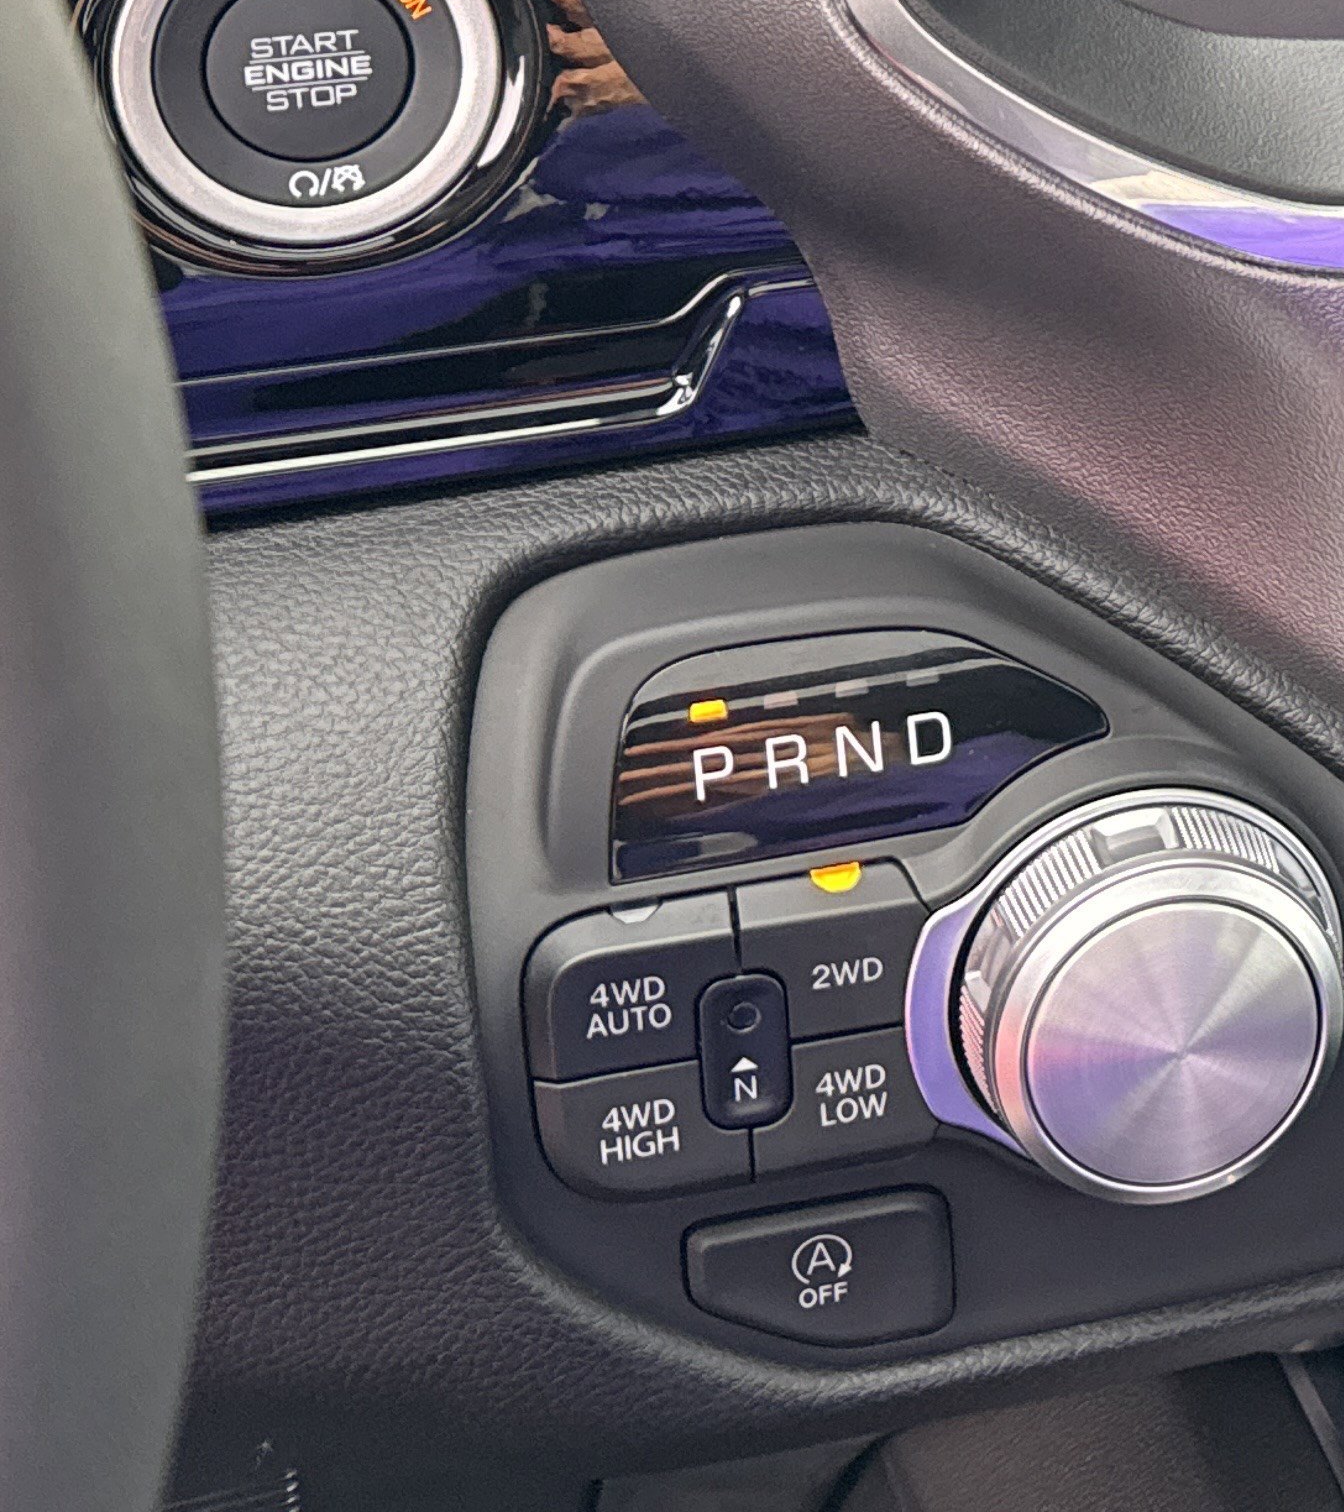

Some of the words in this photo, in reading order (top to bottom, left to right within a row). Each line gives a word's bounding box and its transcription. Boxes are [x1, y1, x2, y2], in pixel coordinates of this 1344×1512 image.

[250, 29, 359, 60] START
[243, 54, 373, 87] ENGINE
[266, 83, 358, 112] STOP
[812, 956, 883, 991] 2WD
[590, 975, 666, 1008] 4WD
[586, 1002, 673, 1039] AUTO
[734, 1075, 758, 1100] N
[815, 1063, 887, 1099] 4WD
[602, 1098, 676, 1133] 4WD
[820, 1092, 888, 1127] LOW
[600, 1126, 681, 1164] HIGH
[798, 1281, 848, 1309] OFF
